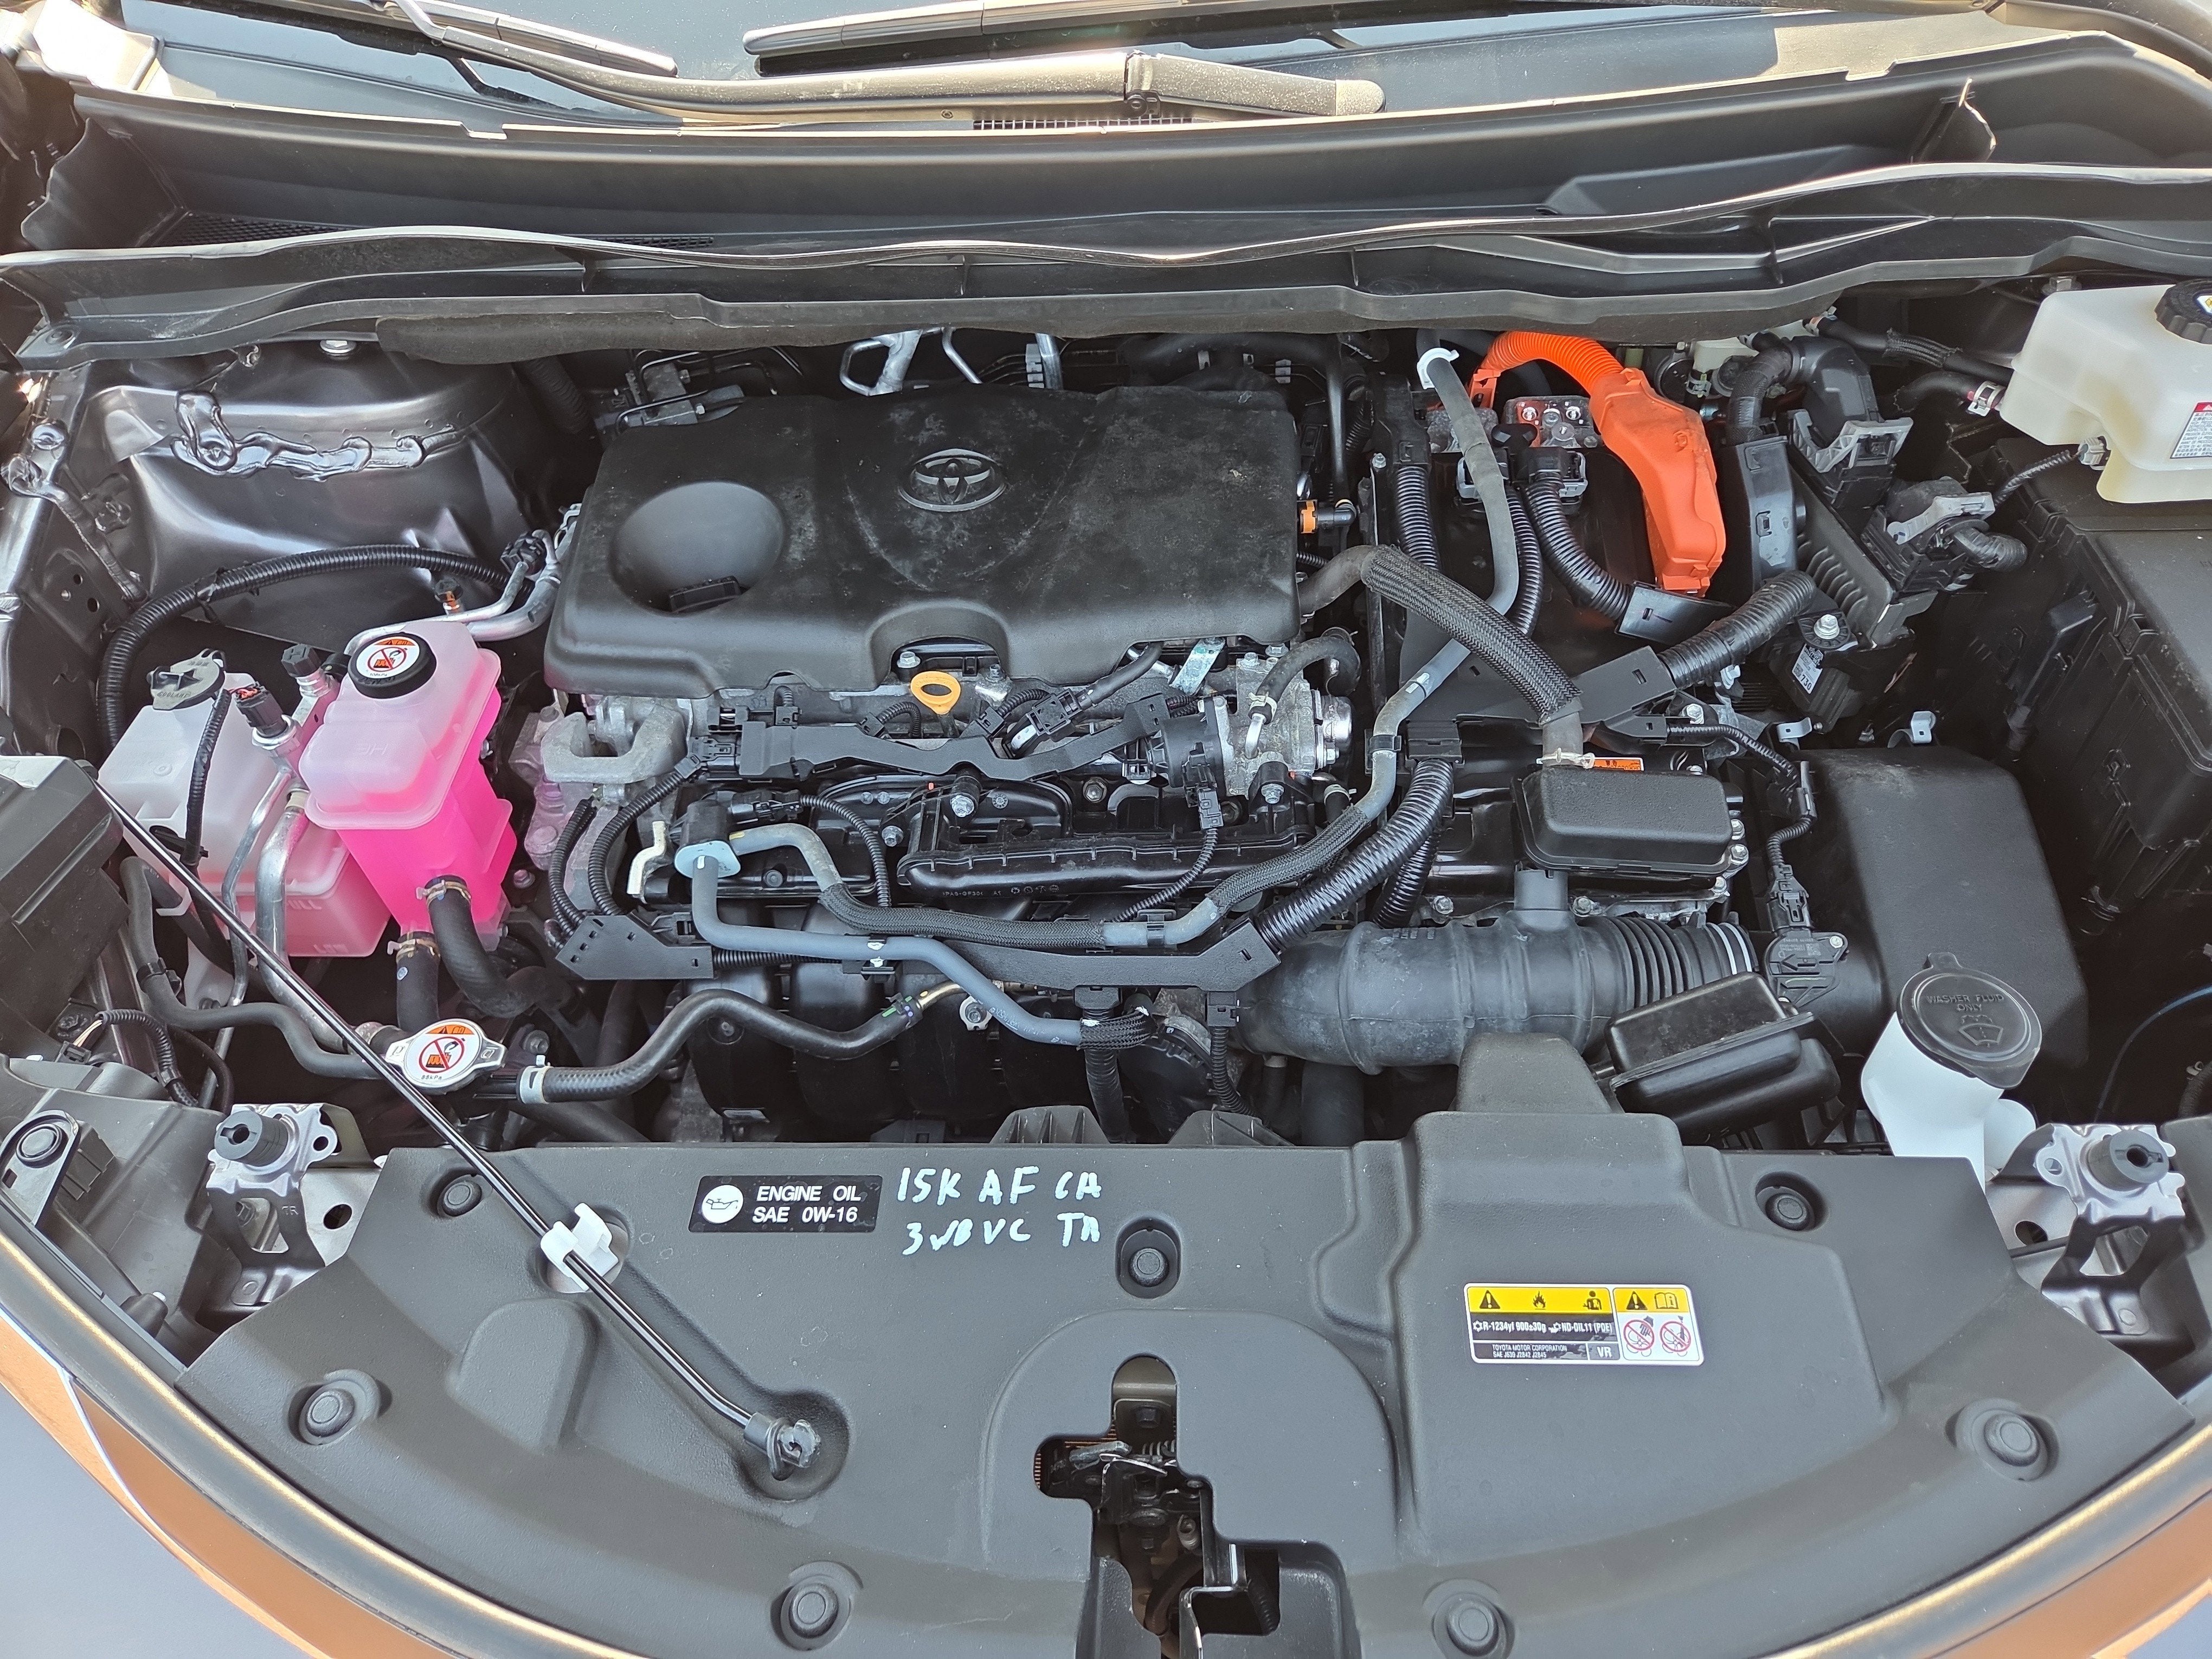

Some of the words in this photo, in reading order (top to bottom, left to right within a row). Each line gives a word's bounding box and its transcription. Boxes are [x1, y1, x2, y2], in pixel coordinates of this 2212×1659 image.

[1801, 674, 1812, 690] 730
[1975, 994, 2003, 1002] FLUID
[757, 1185, 821, 1203] ENGINE
[832, 1185, 861, 1203] OIL
[752, 1206, 789, 1223] SAE
[801, 1206, 858, 1223] 0W-16
[1482, 1321, 1514, 1334] R-1234yf
[1561, 1322, 1592, 1333] ND-OIL11
[1593, 1322, 1613, 1334] (POE)
[1597, 1346, 1612, 1358] VR
